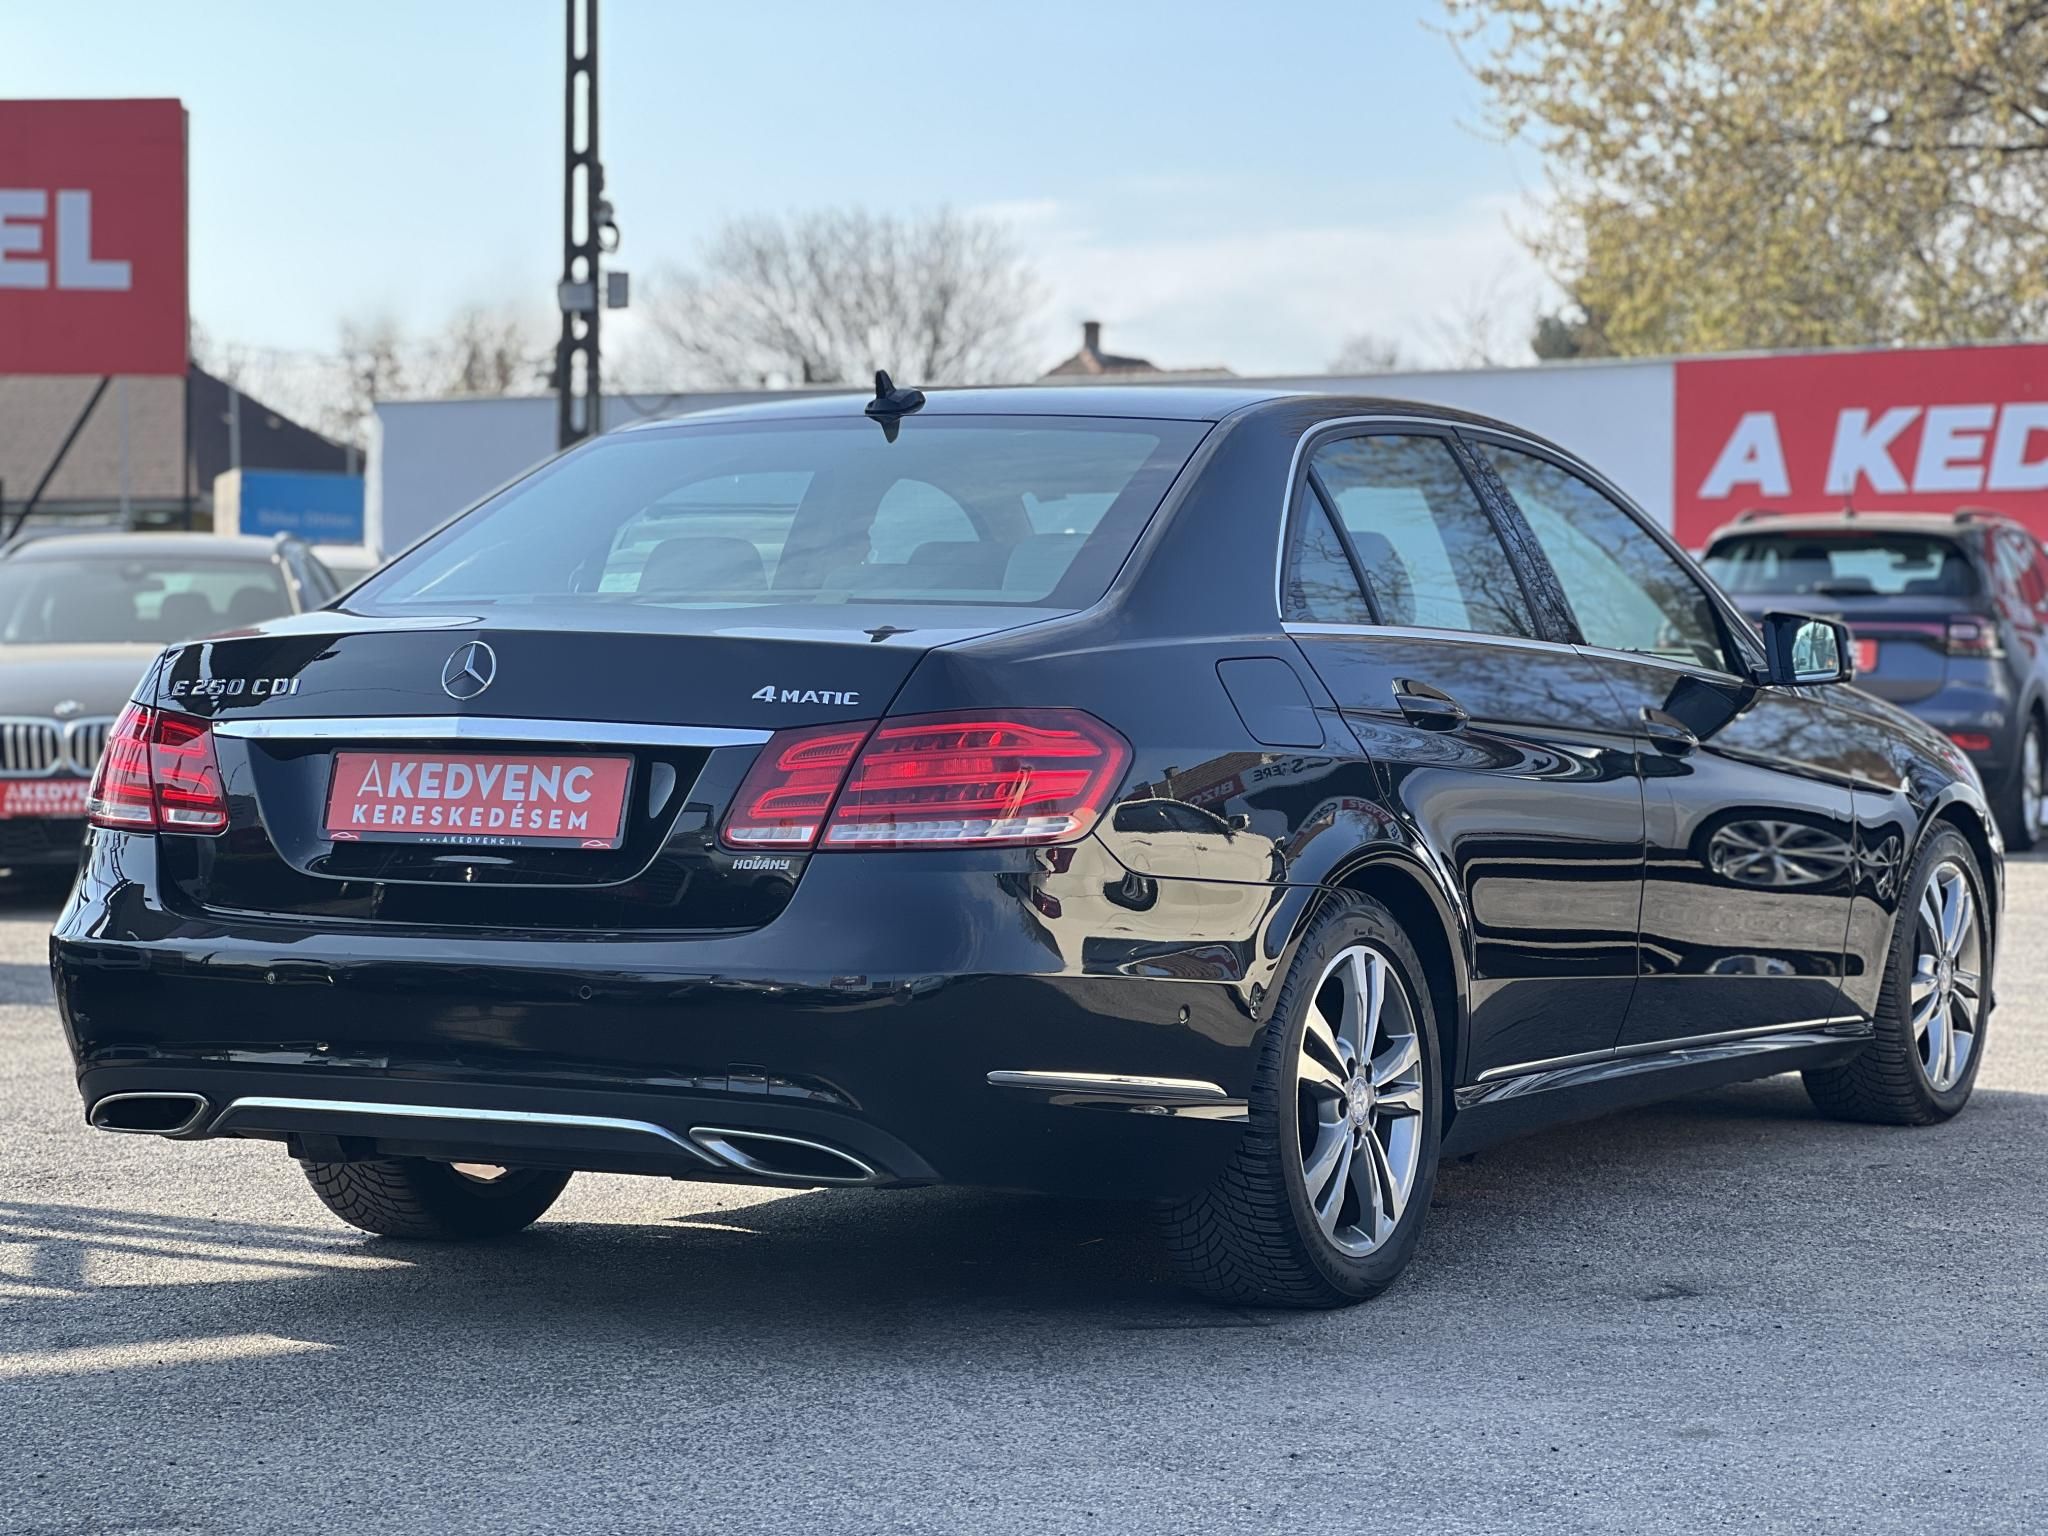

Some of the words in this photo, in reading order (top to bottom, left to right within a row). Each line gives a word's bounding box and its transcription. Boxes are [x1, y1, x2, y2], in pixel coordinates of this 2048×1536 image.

[1698, 411, 1792, 499] A
[1823, 402, 2048, 495] KED
[172, 680, 190, 696] E
[190, 679, 246, 696] 250
[251, 678, 301, 696] CDI
[351, 803, 589, 830] KERESKEDÉSEM
